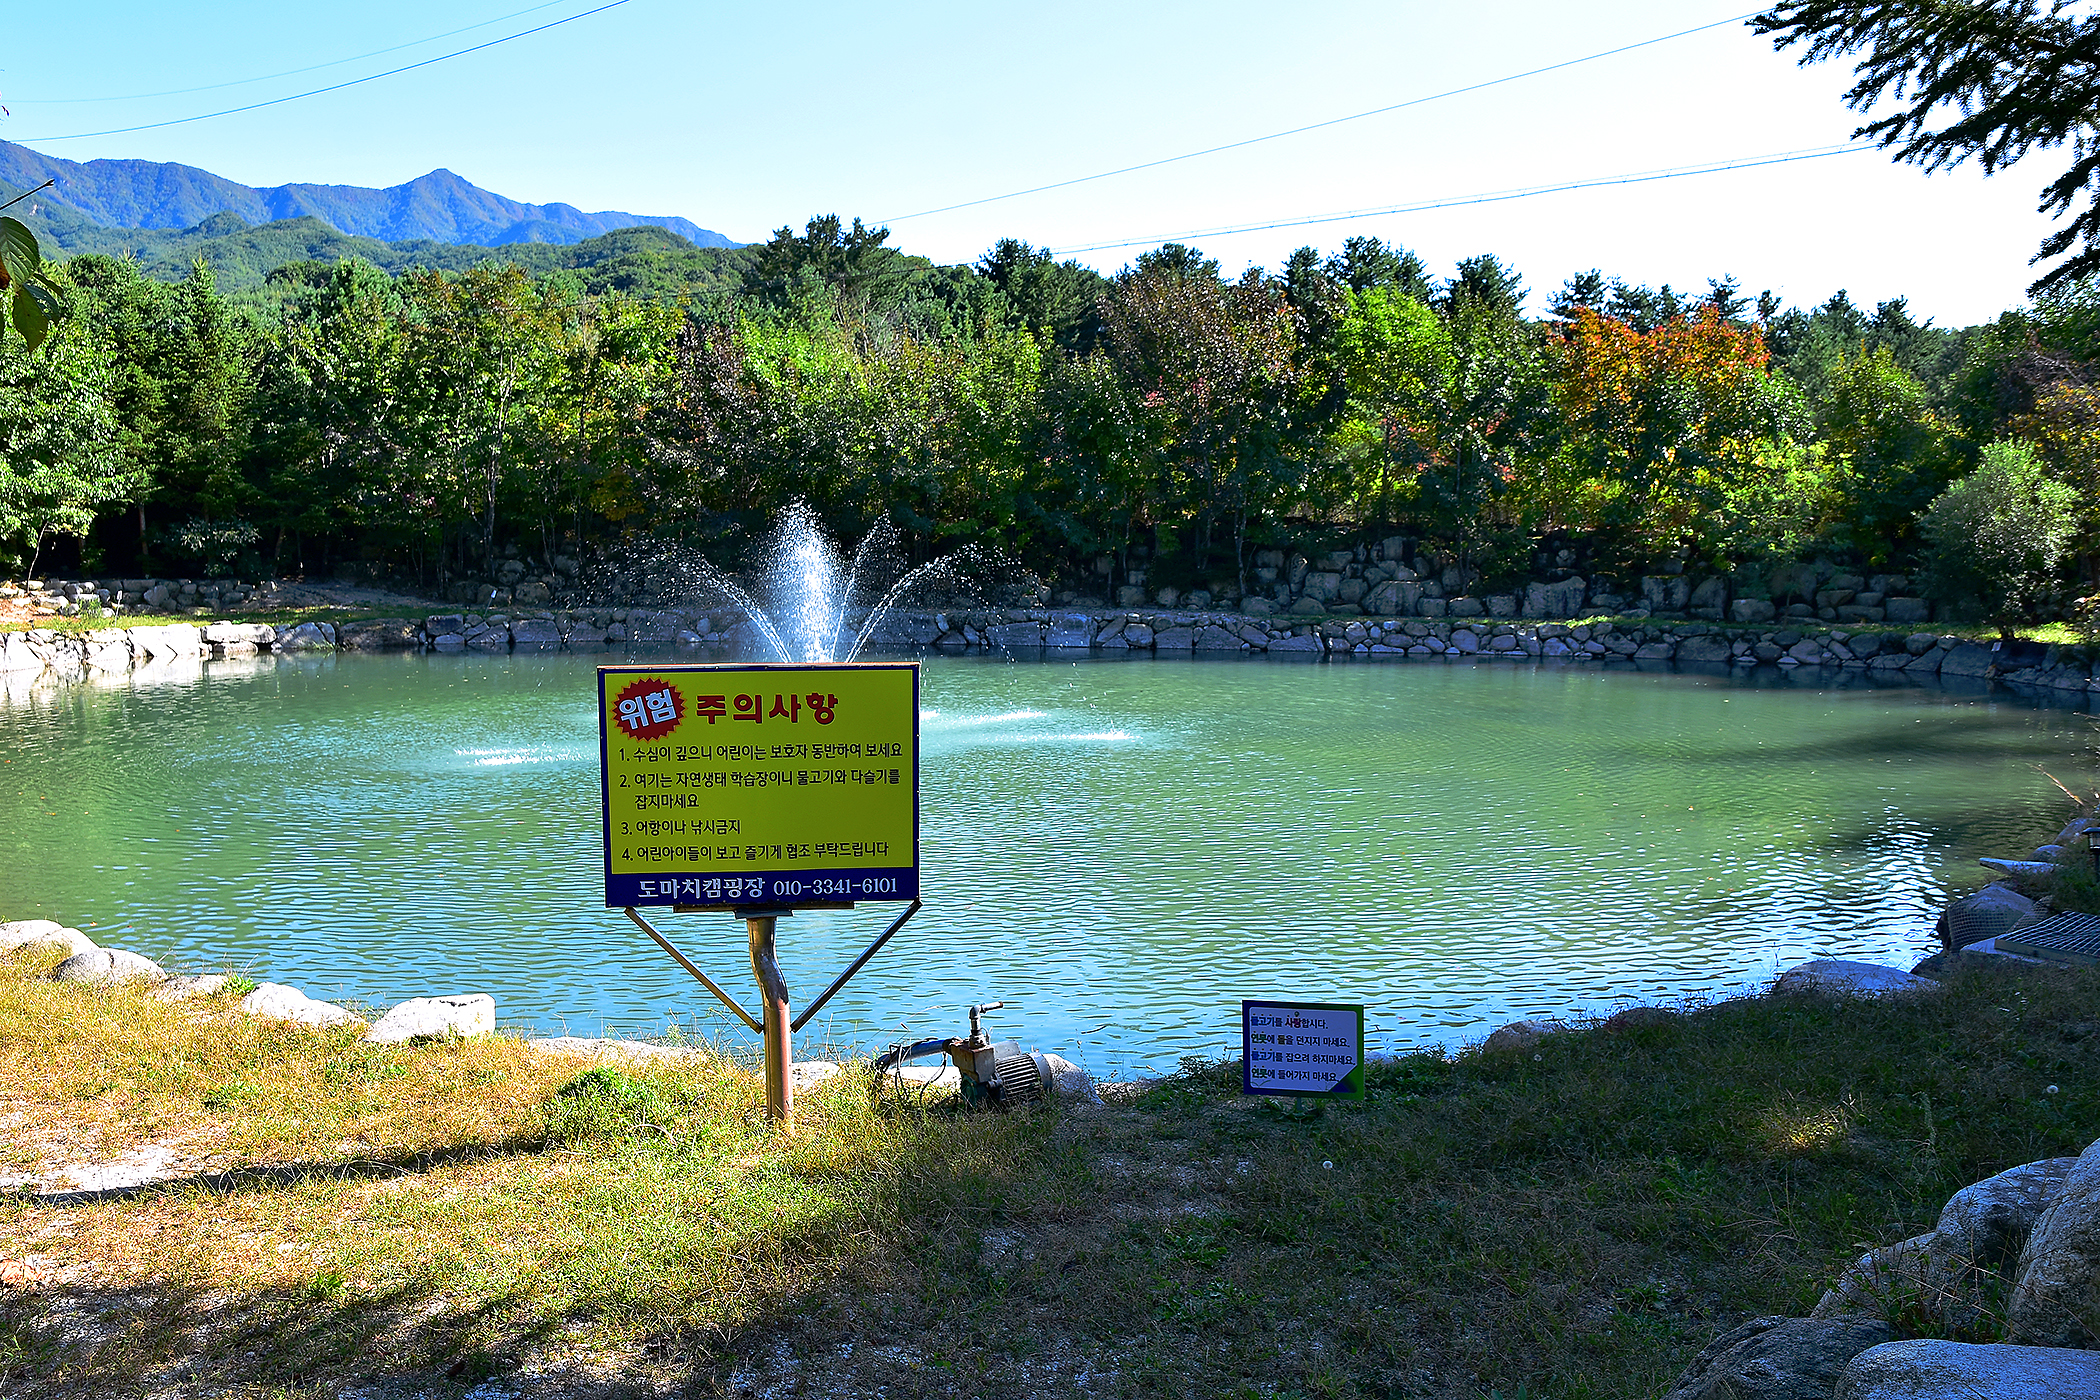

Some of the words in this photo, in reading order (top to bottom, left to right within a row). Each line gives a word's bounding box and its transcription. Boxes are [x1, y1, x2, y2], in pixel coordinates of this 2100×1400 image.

[618, 689, 677, 730] 위험
[696, 692, 839, 724] 주의사항
[619, 748, 629, 761] 1.
[633, 746, 671, 762] 수심이
[675, 746, 713, 761] 깊으니
[716, 745, 766, 760] 어린이는
[770, 744, 808, 759] 보호자
[811, 743, 861, 759] 동반하여
[864, 743, 902, 758] 보세요
[619, 775, 631, 788] 2.
[634, 774, 672, 788] 여기는
[675, 772, 727, 788] 자연생태
[730, 771, 793, 787] 학습장이니
[797, 770, 847, 785] 물고기와
[851, 768, 900, 784] 다슬기를
[635, 793, 699, 810] 잡지마세요
[621, 822, 632, 835] 3.
[636, 820, 686, 836] 어항이나
[690, 819, 741, 835] 낚시금지
[622, 848, 633, 861] 4.
[637, 846, 712, 862] 어린아이들이
[716, 845, 741, 860] 보고
[744, 844, 782, 860] 즐기게
[786, 843, 811, 858] 협조
[814, 841, 889, 858] 부탁드립니다
[638, 877, 765, 899] 도마치캠핑장
[773, 877, 897, 895] 010-3341-6101
[1285, 1015, 1328, 1029] 사랑합시다.
[1251, 1033, 1274, 1044] 연못에
[1296, 1036, 1320, 1046] 던지지
[1323, 1036, 1350, 1047] 마세요.
[1286, 1053, 1309, 1063] 잡으려
[1312, 1054, 1356, 1065] 하지마세요.
[1251, 1067, 1275, 1078] 연못에
[1278, 1070, 1309, 1079] 들어가지
